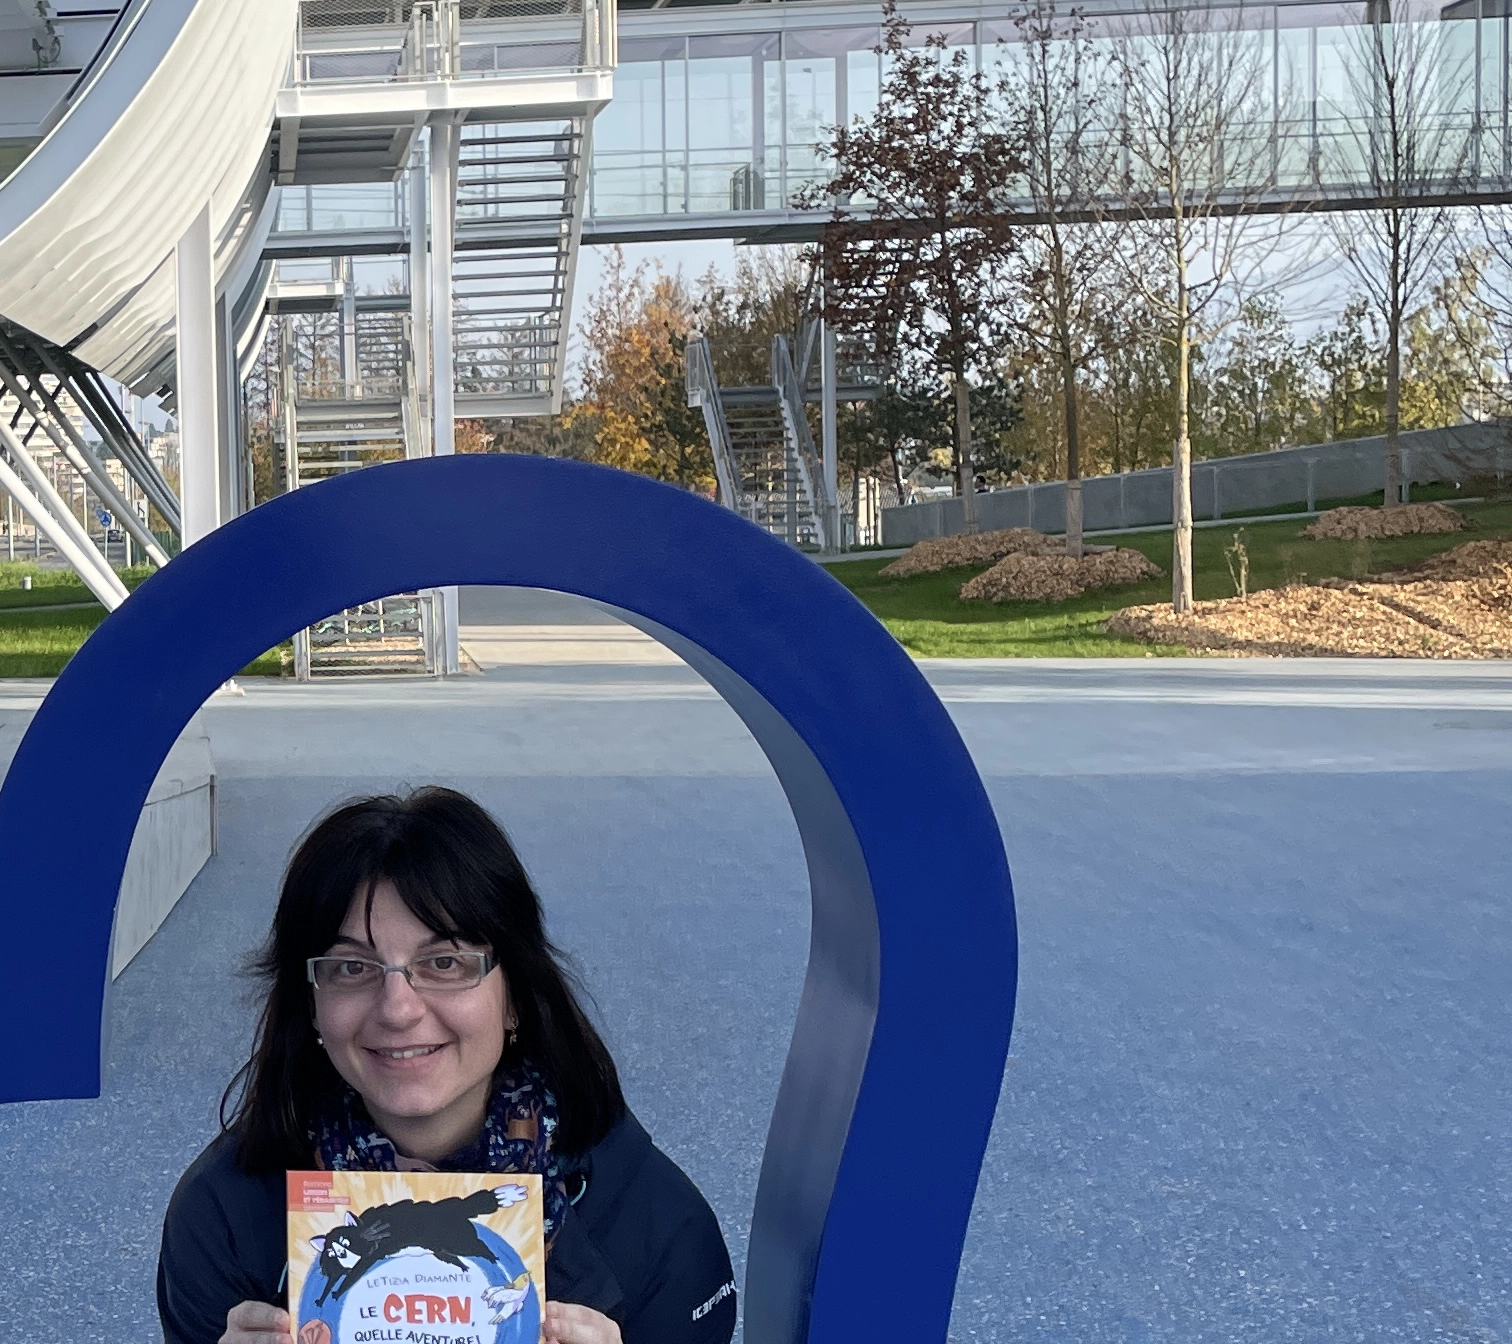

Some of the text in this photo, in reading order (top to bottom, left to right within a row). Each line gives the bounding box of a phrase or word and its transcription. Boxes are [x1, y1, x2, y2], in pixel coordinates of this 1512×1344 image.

[367, 1273, 473, 1289] LETIZIA DIAMANTE
[359, 1292, 476, 1328] LE CERN,
[354, 1328, 404, 1343] QUELLE
